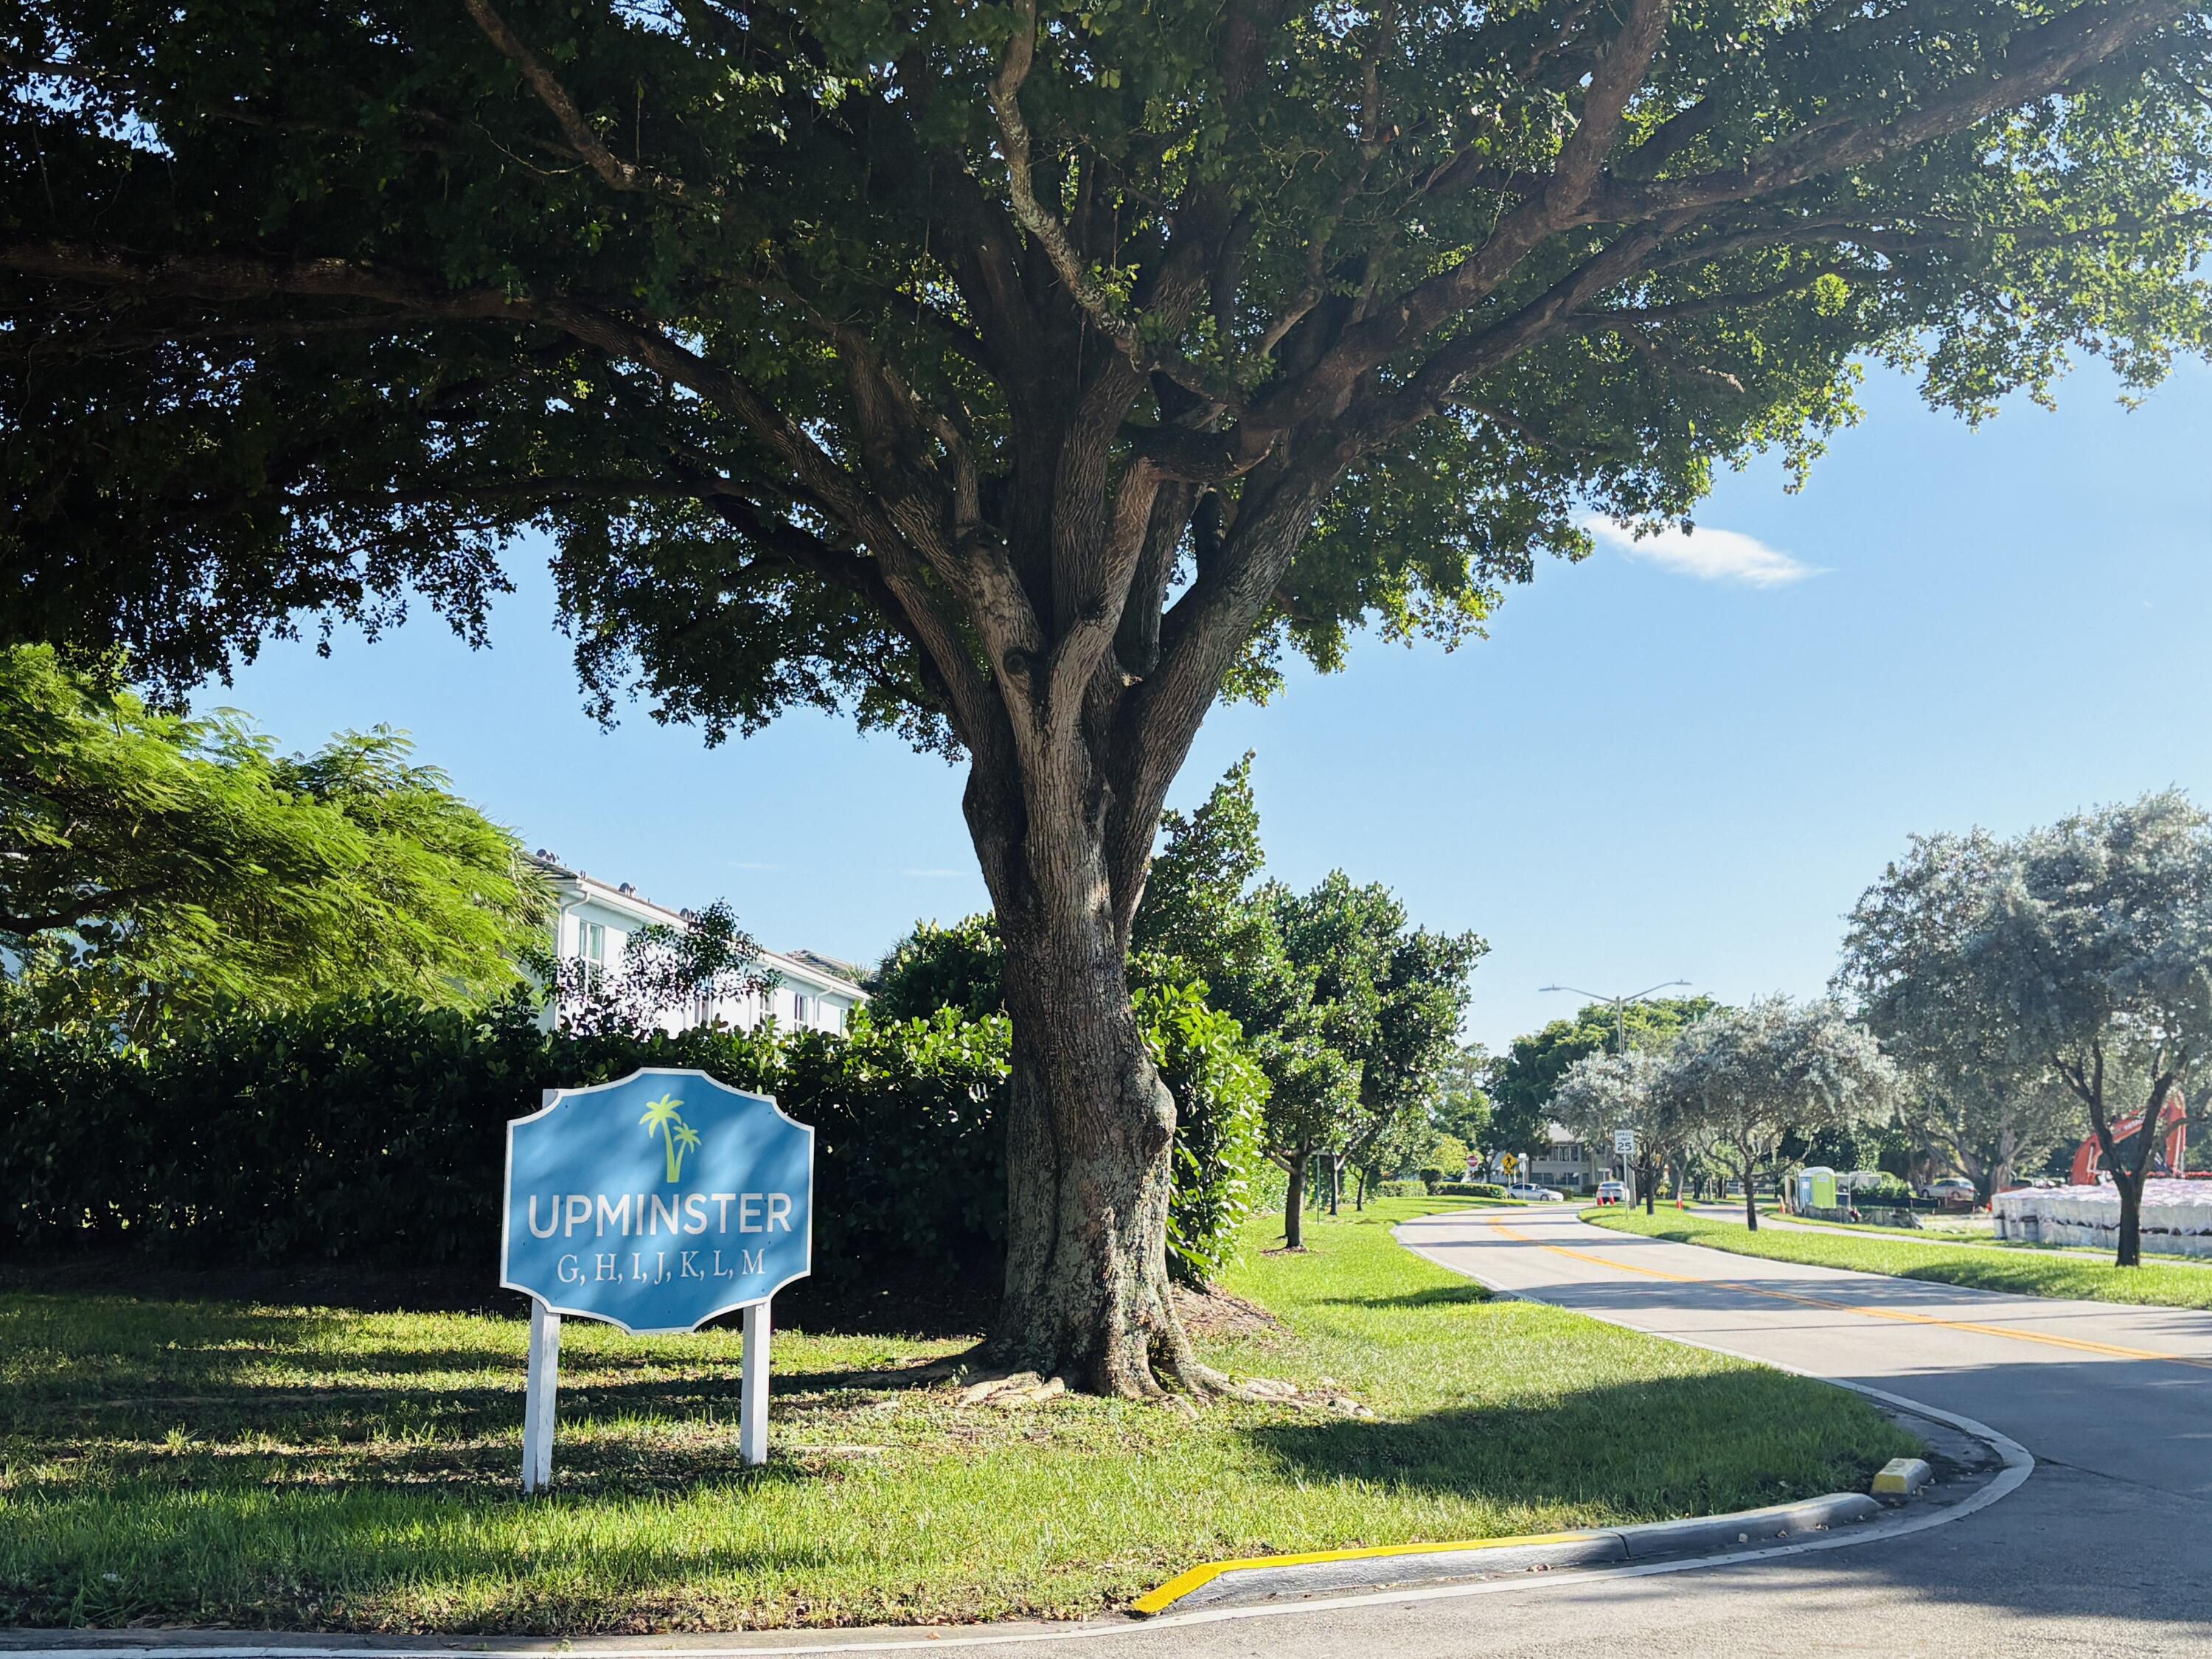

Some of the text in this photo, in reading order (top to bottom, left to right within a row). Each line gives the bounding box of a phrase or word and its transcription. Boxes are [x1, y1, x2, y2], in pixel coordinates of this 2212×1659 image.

[1618, 1142, 1632, 1151] 25
[529, 1193, 792, 1239] UPMINSTER
[557, 1248, 766, 1286] G, H, I, J, K, L, M
